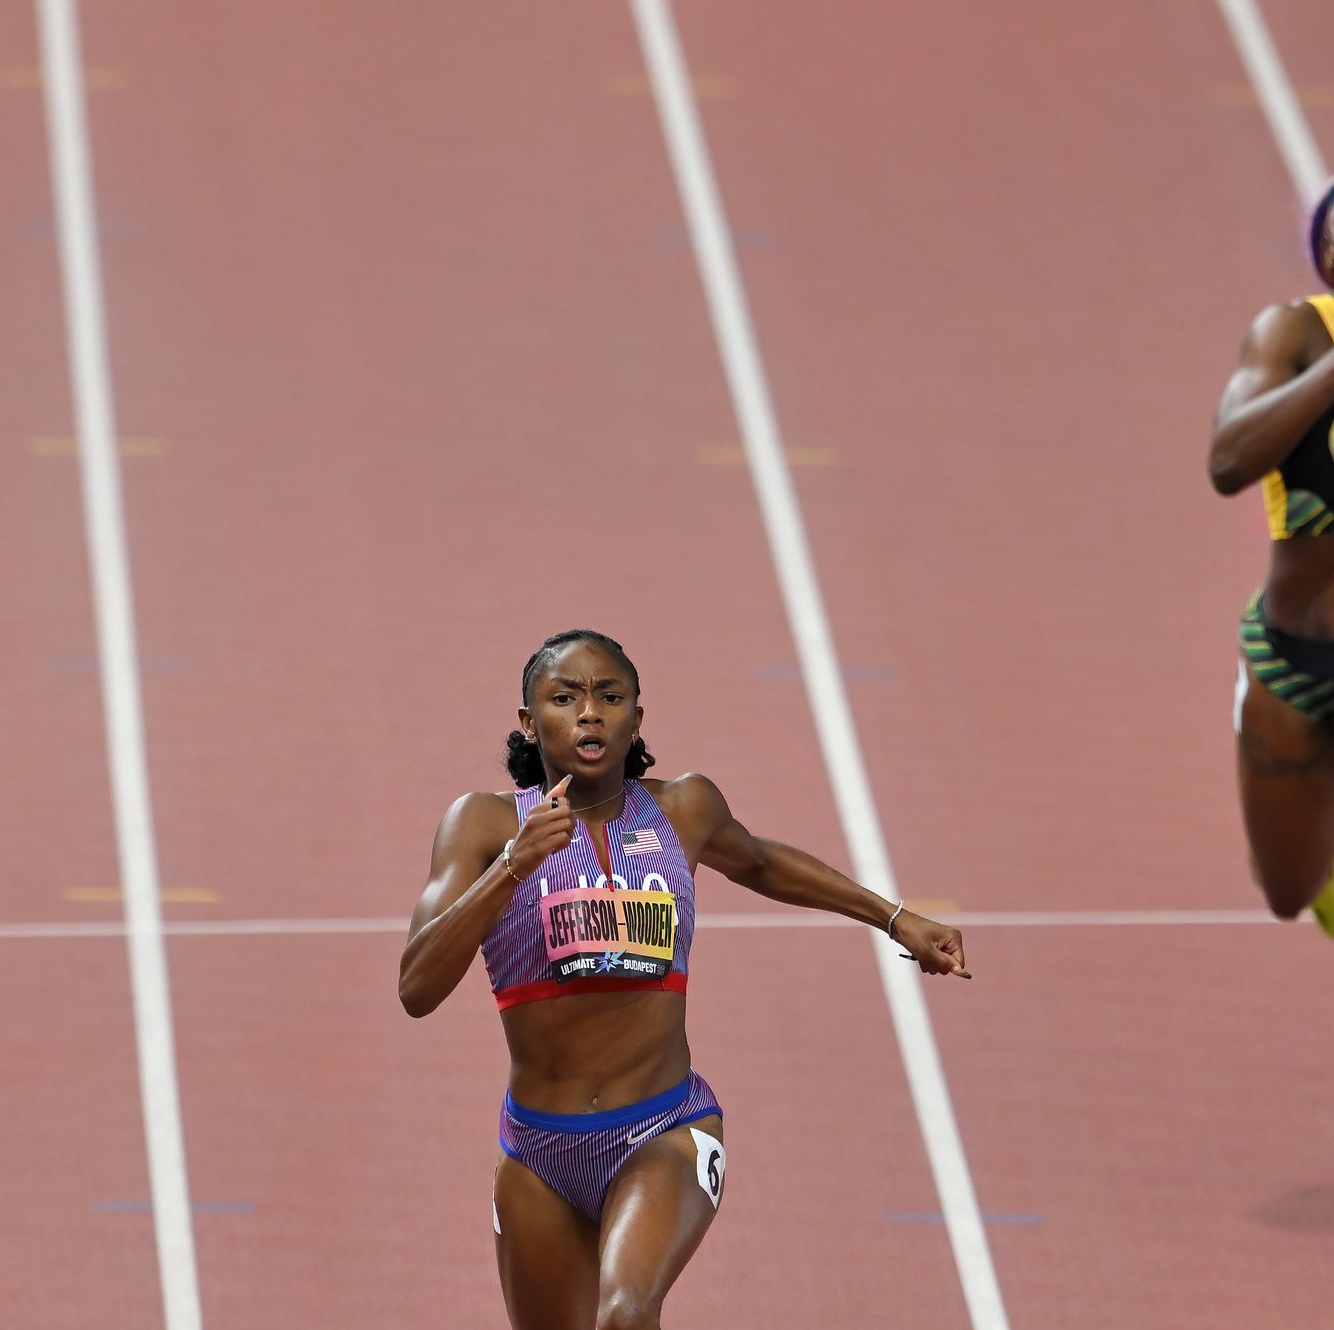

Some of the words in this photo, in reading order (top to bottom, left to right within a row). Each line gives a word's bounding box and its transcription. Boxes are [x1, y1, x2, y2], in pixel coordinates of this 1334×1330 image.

[548, 899, 673, 949] JEFFERSON-WOODEN
[560, 958, 596, 976] ULTIMATE
[623, 958, 657, 974] BUDAPEST
[707, 1149, 721, 1197] 6
